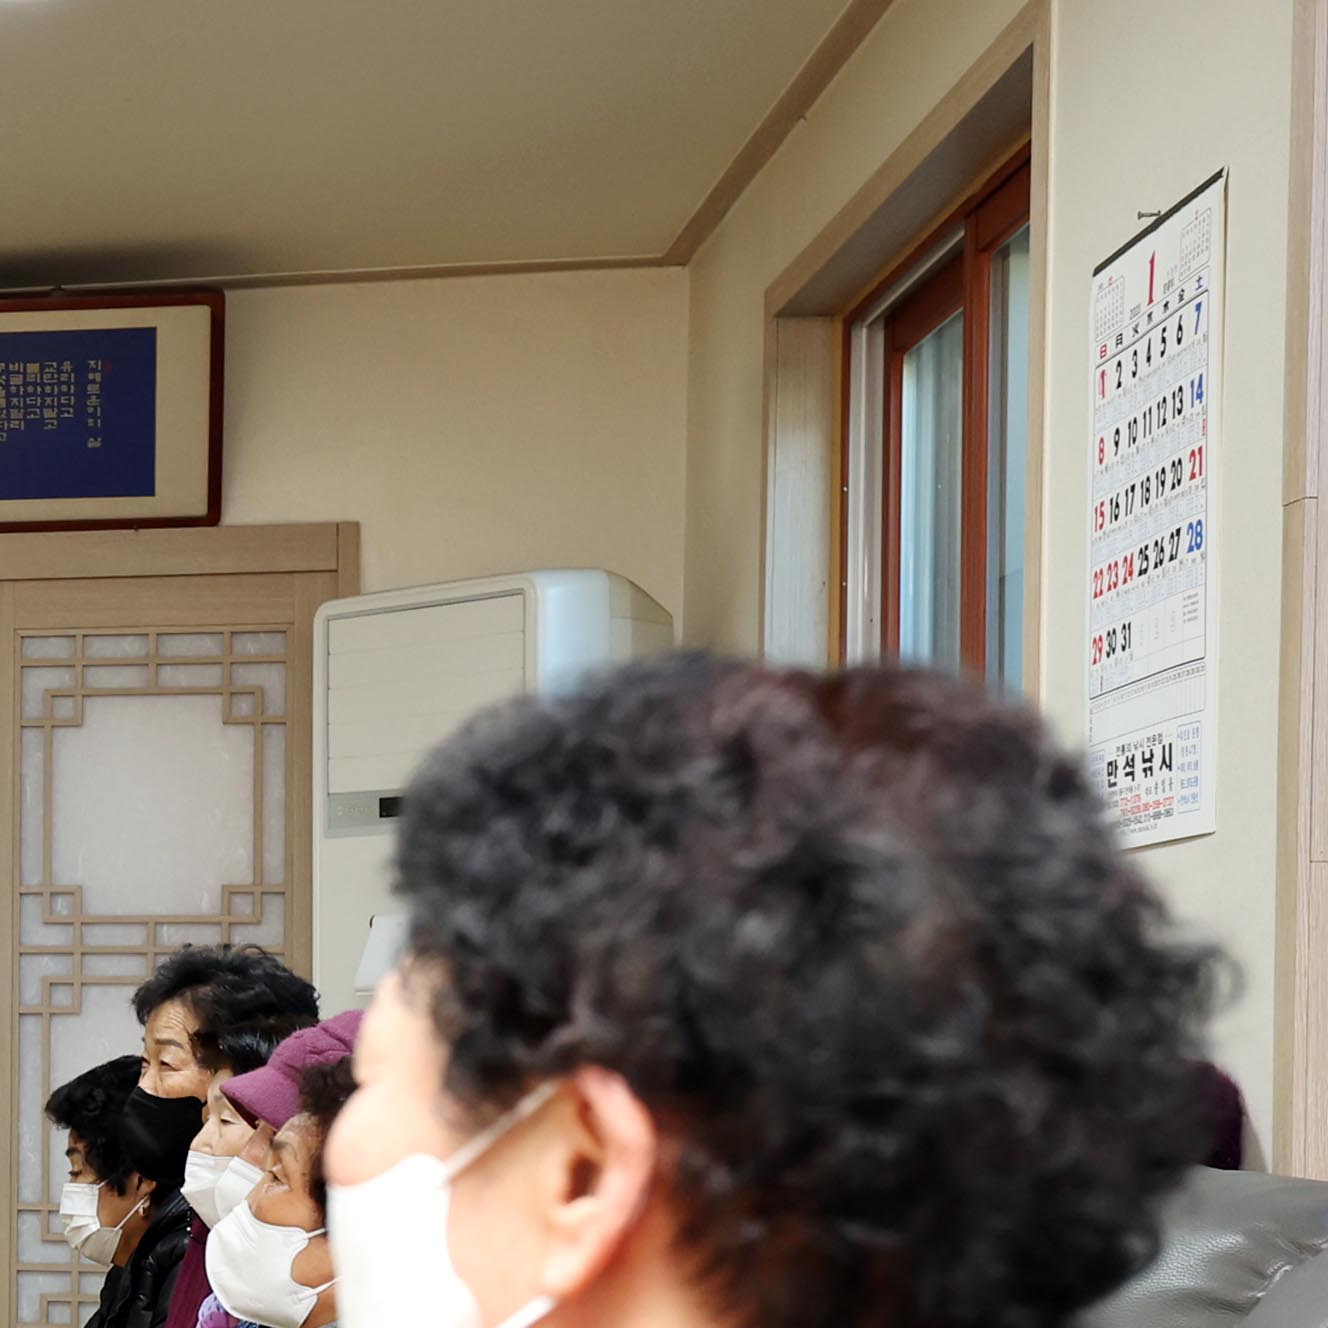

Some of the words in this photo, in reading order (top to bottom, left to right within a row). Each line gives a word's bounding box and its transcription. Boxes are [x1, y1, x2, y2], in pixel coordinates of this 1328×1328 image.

[1147, 249, 1156, 305] 1
[1099, 368, 1107, 400] 1
[1115, 359, 1123, 390] 2
[1131, 349, 1138, 379] 3
[1145, 337, 1152, 367] 4
[1159, 325, 1168, 358] 5
[1176, 314, 1184, 346] 6
[1194, 300, 1203, 335] 7
[1098, 436, 1105, 466] 8
[1113, 427, 1121, 457] 9
[1127, 416, 1138, 449] 10
[1142, 405, 1153, 436] 11
[1156, 395, 1168, 429] 12
[1172, 384, 1184, 419] 13
[1190, 372, 1204, 409] 14
[1094, 500, 1105, 533] 15
[1108, 492, 1120, 525] 16
[1125, 483, 1136, 517] 17
[1140, 475, 1151, 508] 18
[1155, 465, 1166, 498] 19
[1170, 457, 1183, 492] 20
[1189, 444, 1204, 481] 21
[1093, 567, 1104, 600] 22
[1106, 559, 1119, 593] 23
[1122, 552, 1134, 585] 24
[1137, 544, 1150, 578] 25
[1152, 536, 1165, 570] 26
[1168, 527, 1182, 563] 27
[1186, 519, 1204, 554] 28
[1092, 634, 1104, 666] 29
[1106, 627, 1118, 659] 30
[1120, 621, 1132, 653] 31
